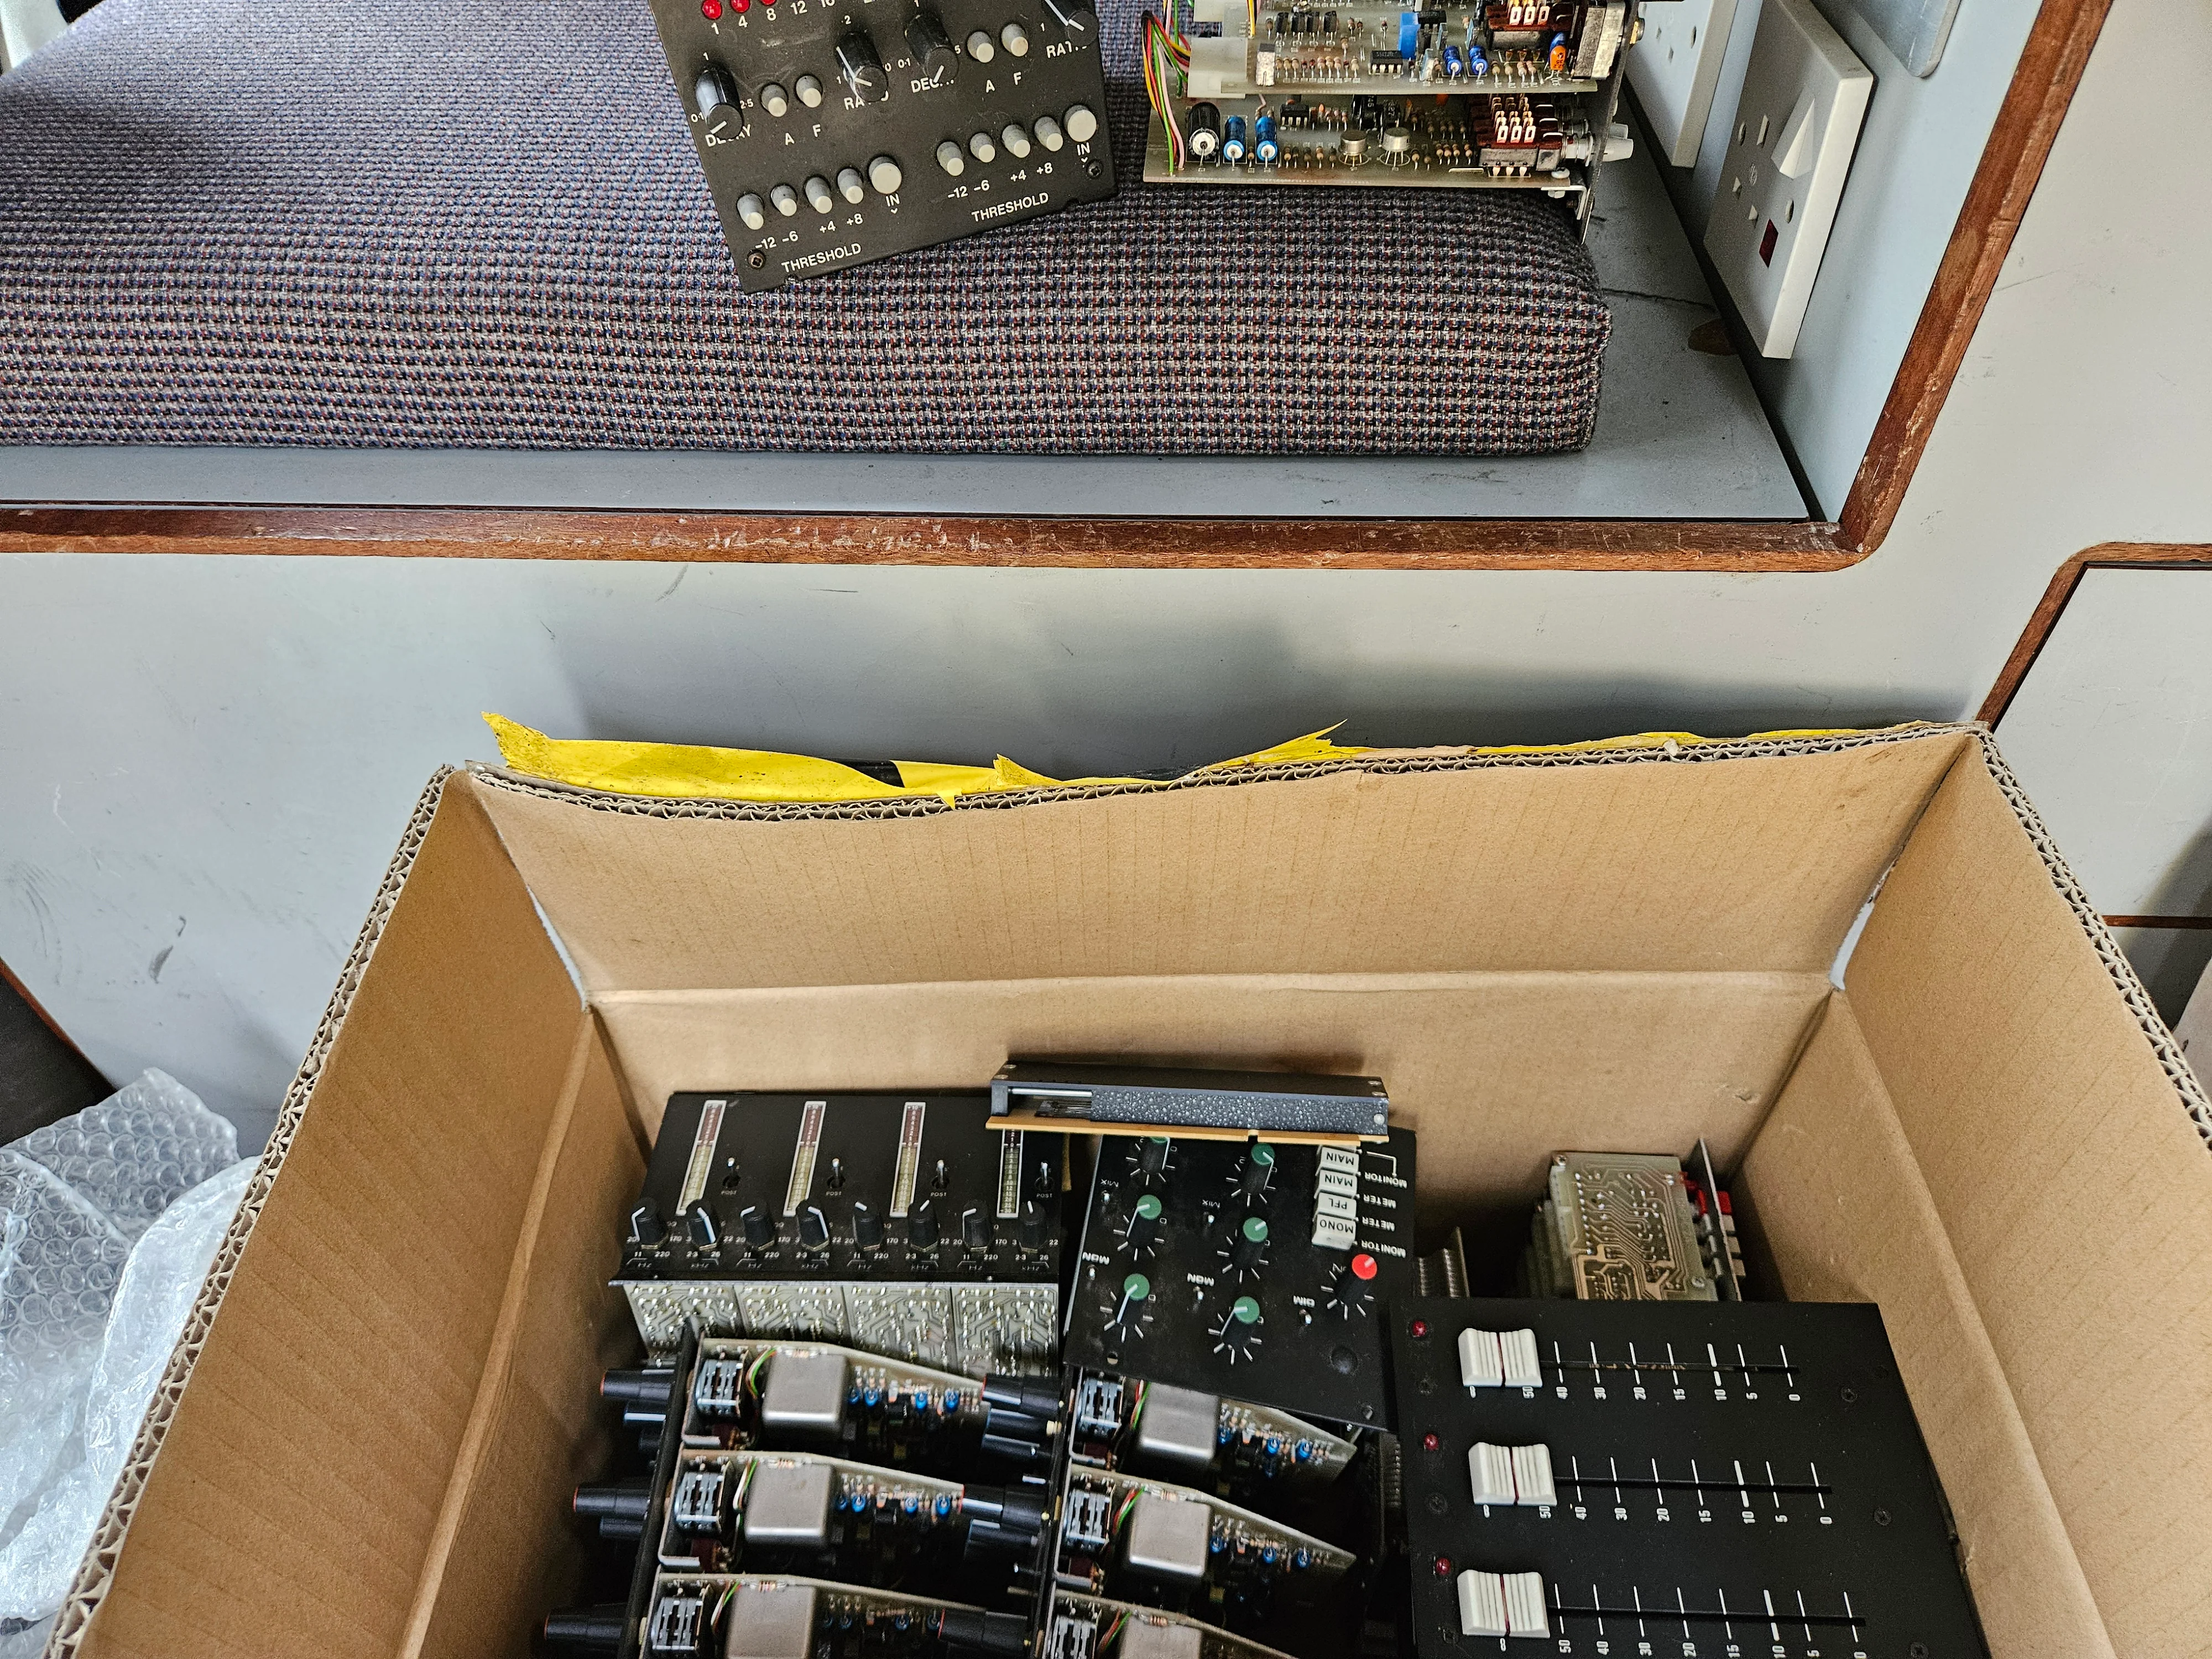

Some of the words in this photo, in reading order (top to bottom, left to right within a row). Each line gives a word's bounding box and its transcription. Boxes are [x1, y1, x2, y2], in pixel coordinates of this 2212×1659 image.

[790, 0, 808, 15] 12
[738, 15, 748, 28] 4
[766, 8, 776, 22] 8
[711, 22, 719, 35] 1
[703, 52, 709, 61] 1
[1013, 72, 1022, 85] F
[985, 80, 995, 93] A
[812, 124, 822, 137] F
[785, 133, 795, 145] A
[1077, 142, 1091, 156] IN
[947, 185, 968, 199] -12
[974, 180, 990, 191] -6
[1010, 169, 1027, 182] +4
[1036, 162, 1053, 175] +8
[886, 193, 900, 207] IN
[971, 192, 1049, 222] THRESHOLD
[755, 237, 777, 249] -12
[782, 230, 799, 242] -6
[820, 220, 836, 233] +4
[846, 213, 863, 226] +8
[781, 242, 862, 273] THRESHOLD
[1326, 1152, 1354, 1166] MAIN
[1100, 1178, 1119, 1188] MIX
[1324, 1174, 1353, 1187] MAIN
[1364, 1172, 1407, 1189] MONITOR
[1202, 1199, 1220, 1208] MIX
[1328, 1198, 1348, 1210] PFL
[1363, 1193, 1397, 1209] METER
[1319, 1219, 1354, 1234] MONO
[1362, 1216, 1395, 1232] METER
[1361, 1240, 1406, 1259] MONITOR
[1082, 1251, 1110, 1265] MON
[1187, 1272, 1214, 1287] MON
[1522, 1386, 1535, 1399] 50
[1556, 1386, 1568, 1400] 40
[1593, 1387, 1606, 1400] 30
[1633, 1387, 1647, 1401] 20
[1673, 1389, 1686, 1401] 15
[1714, 1389, 1727, 1401] 10
[1538, 1505, 1551, 1519] 50
[1574, 1506, 1587, 1520] 40
[1614, 1507, 1627, 1521] 30
[1656, 1508, 1670, 1522] 20
[1698, 1510, 1712, 1522] 15
[1742, 1511, 1755, 1524] 10
[1558, 1640, 1571, 1653] 50
[1597, 1641, 1609, 1655] 40
[1638, 1642, 1652, 1656] 30
[1682, 1642, 1697, 1657] 20
[1726, 1644, 1740, 1658] 15
[1772, 1645, 1786, 1658] 10
